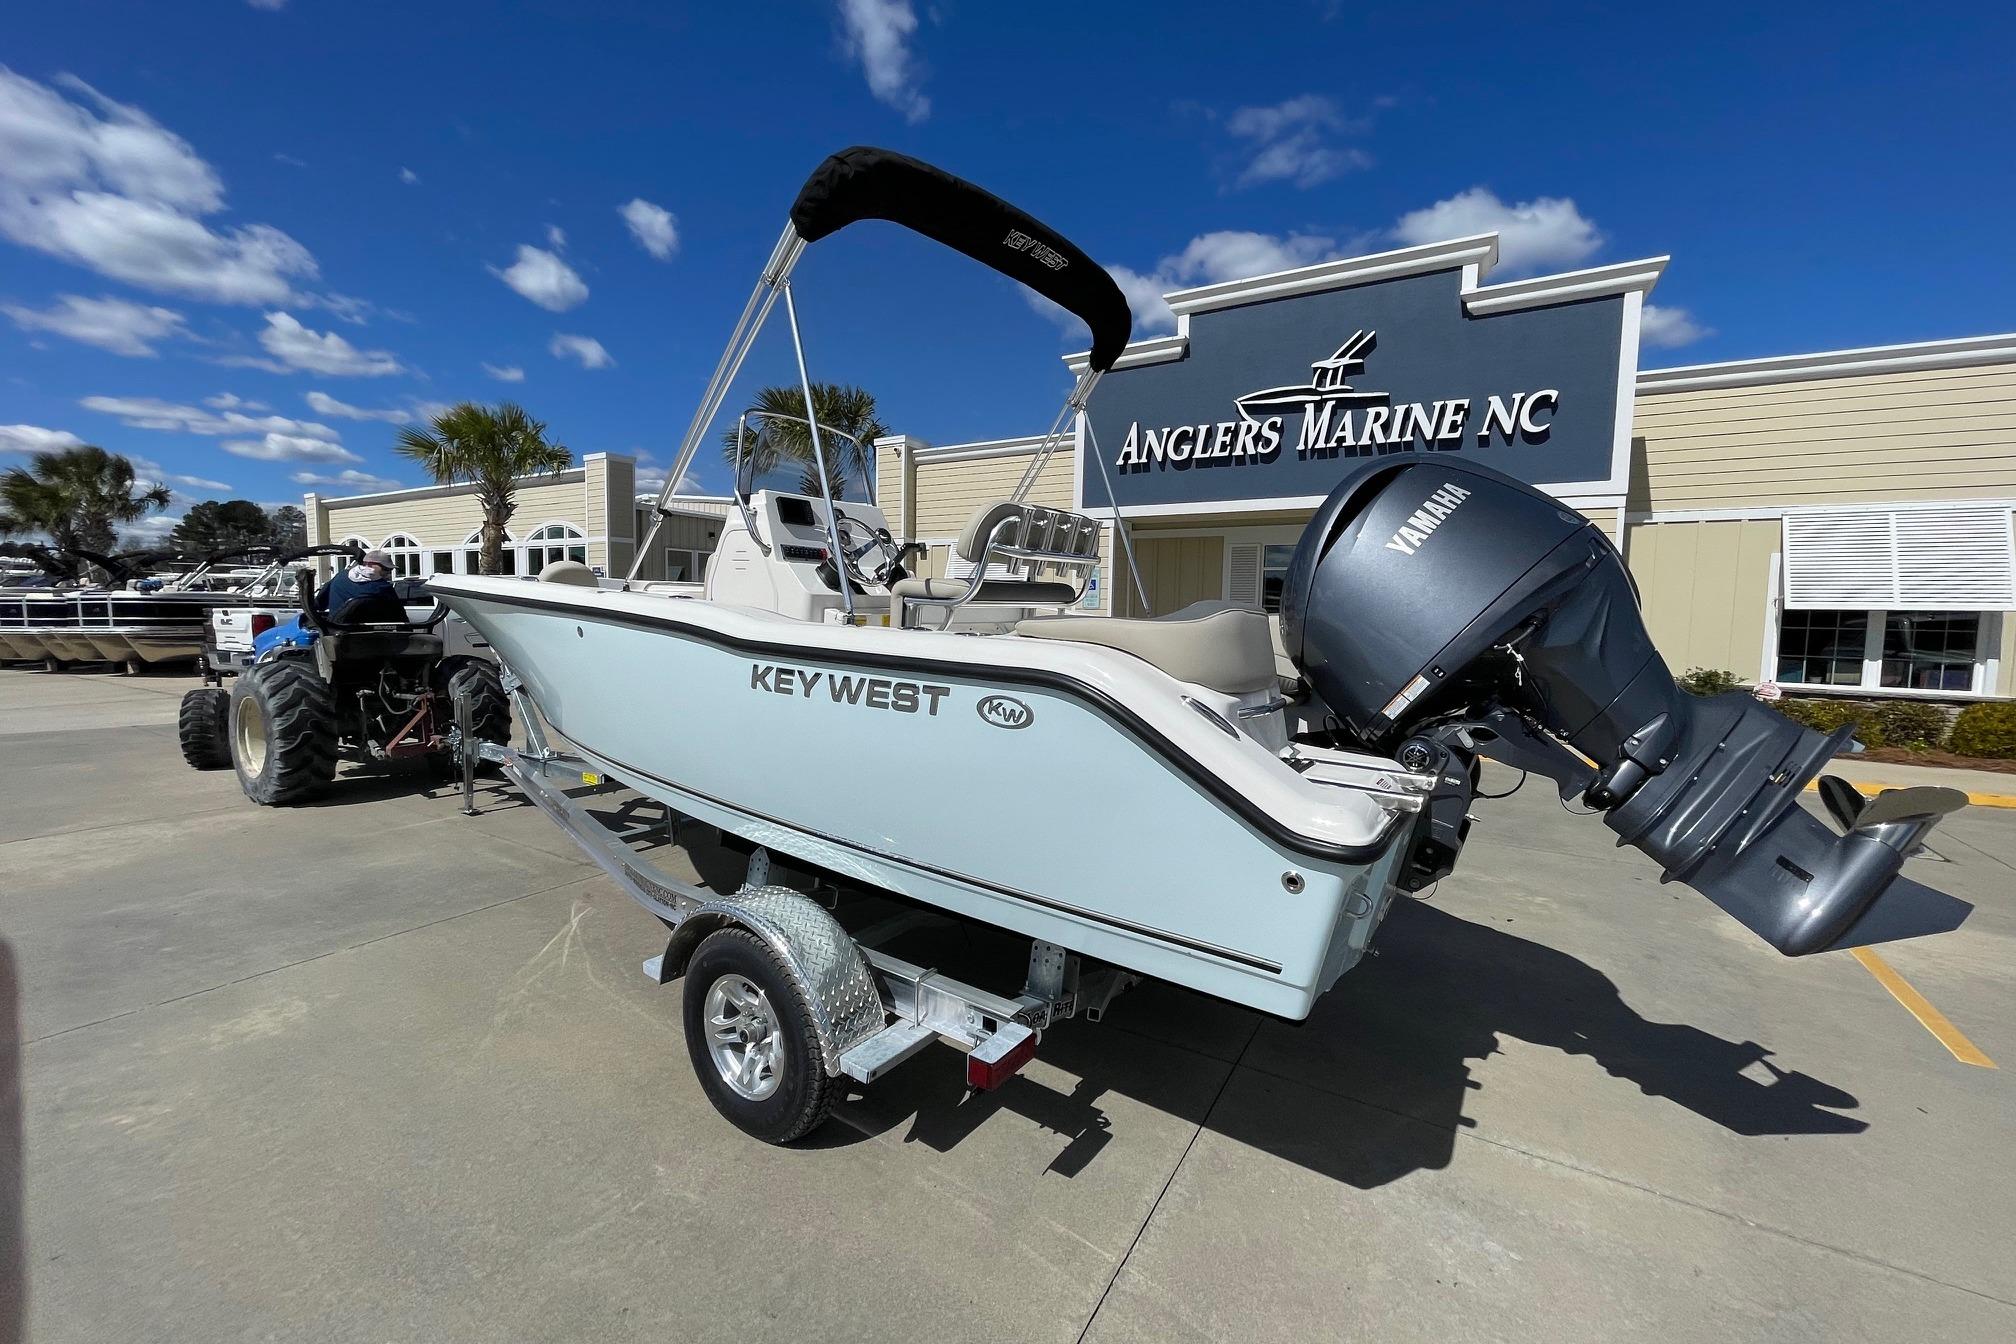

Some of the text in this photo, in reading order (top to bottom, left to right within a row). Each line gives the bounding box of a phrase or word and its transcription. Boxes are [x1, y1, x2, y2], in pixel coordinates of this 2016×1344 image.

[1003, 229, 1068, 270] KEY WEST
[1116, 389, 1559, 466] ANGLERS MARINE NC
[1385, 482, 1472, 556] YAMAHA
[750, 664, 951, 716] KEY WEST
[987, 700, 1025, 724] KW
